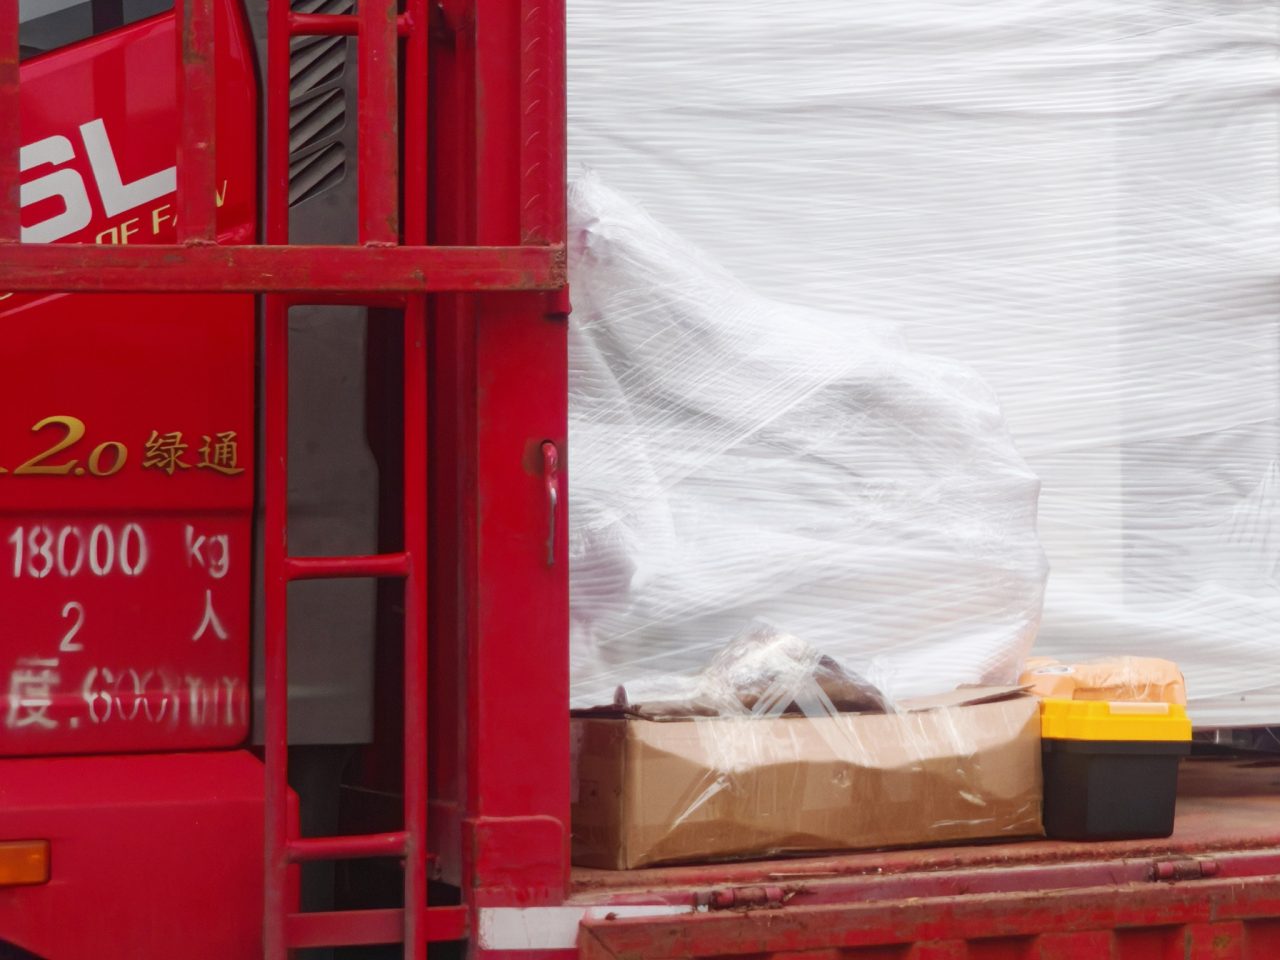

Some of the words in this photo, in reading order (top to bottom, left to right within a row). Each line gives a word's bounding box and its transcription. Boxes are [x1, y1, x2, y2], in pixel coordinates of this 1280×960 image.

[142, 429, 246, 476] 绿通
[9, 523, 148, 579] 18000
[185, 524, 230, 579] kg
[58, 600, 85, 652] 2
[191, 589, 229, 641] 人
